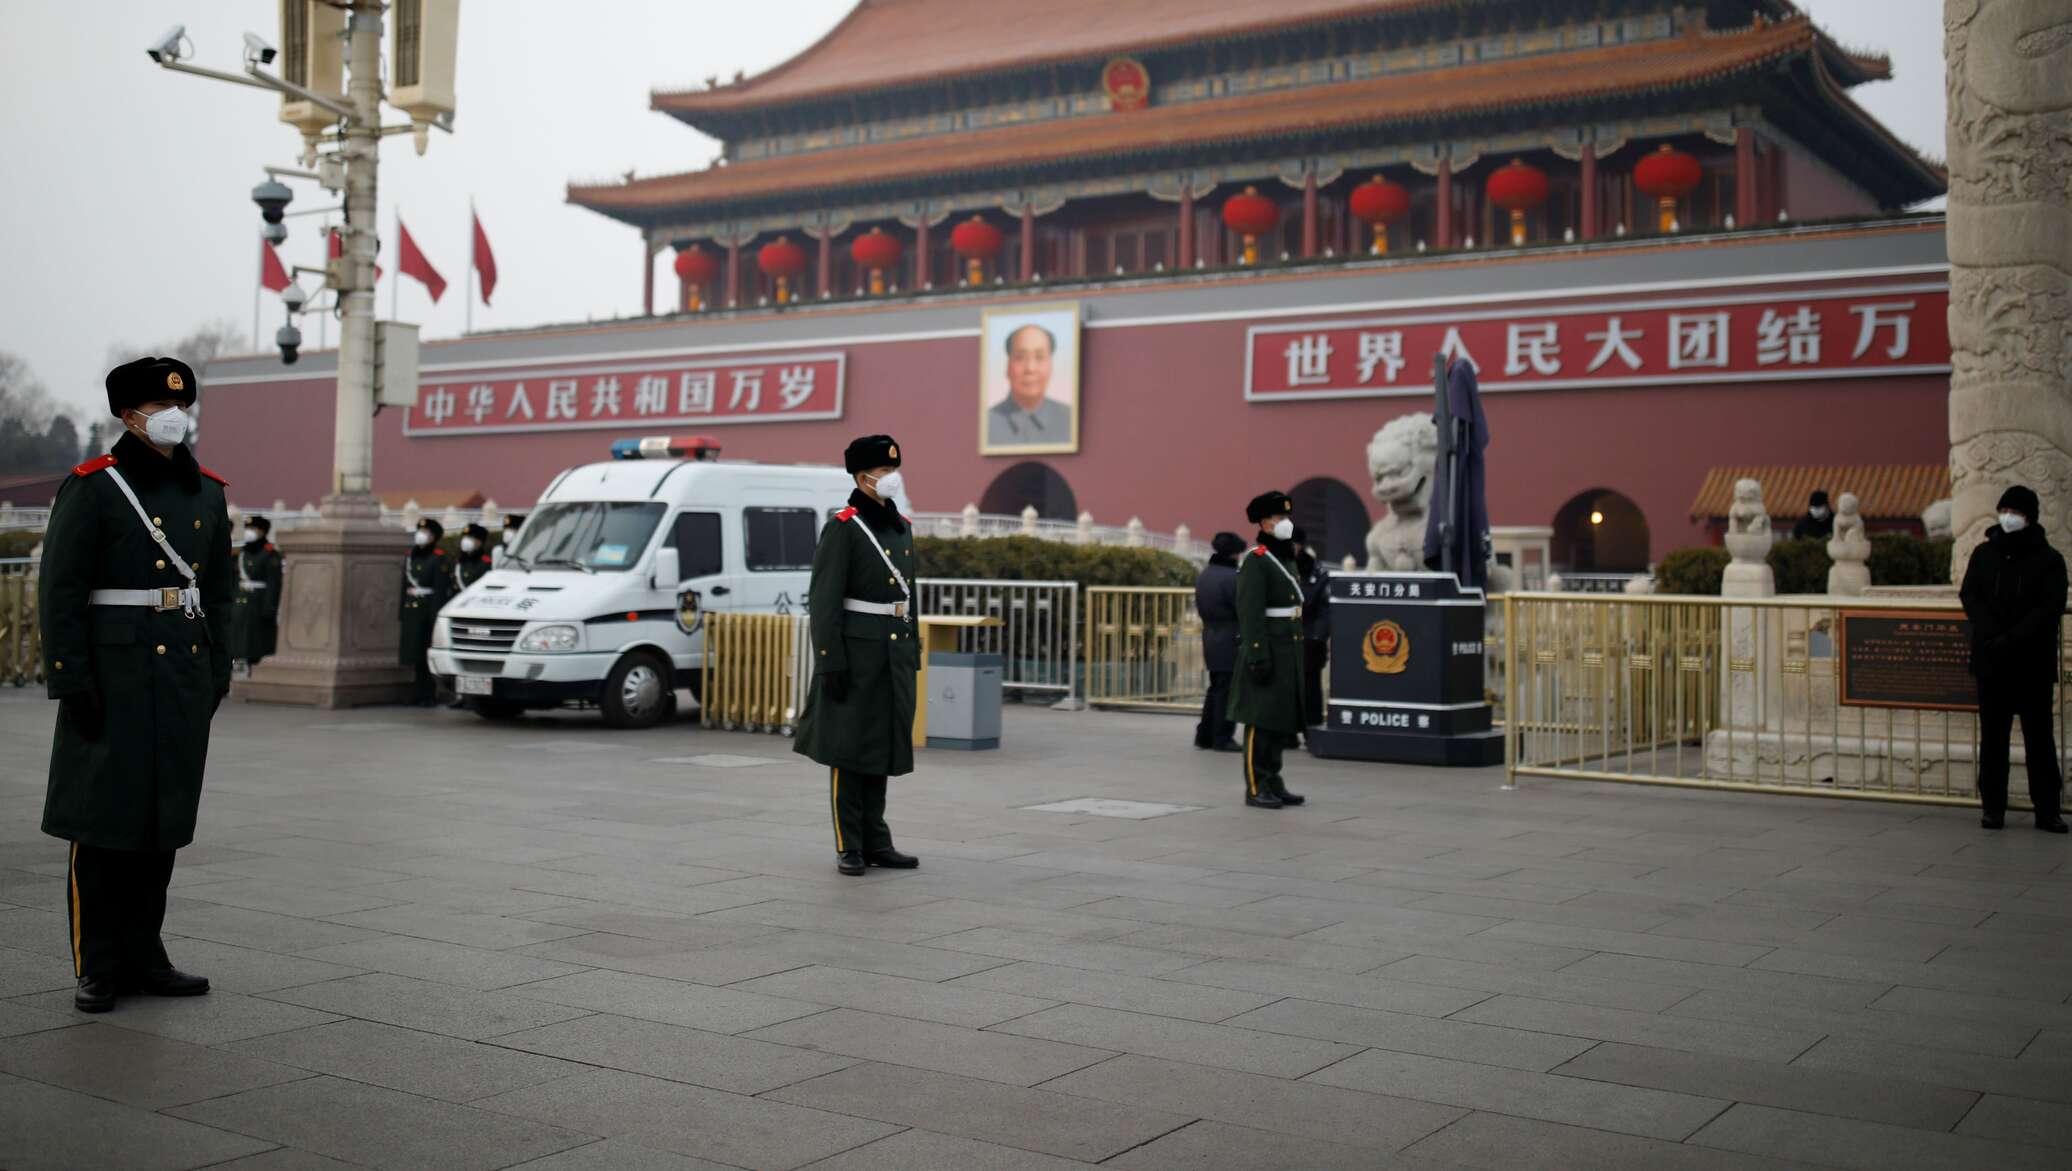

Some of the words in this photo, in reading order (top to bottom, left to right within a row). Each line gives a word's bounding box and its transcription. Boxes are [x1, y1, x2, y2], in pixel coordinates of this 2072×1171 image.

[1284, 301, 1916, 386] 世界人民大团结万
[424, 366, 816, 424] 中华人民共和国万岁
[1350, 583, 1420, 598] 天安门分局
[1360, 711, 1410, 728] POLICE
